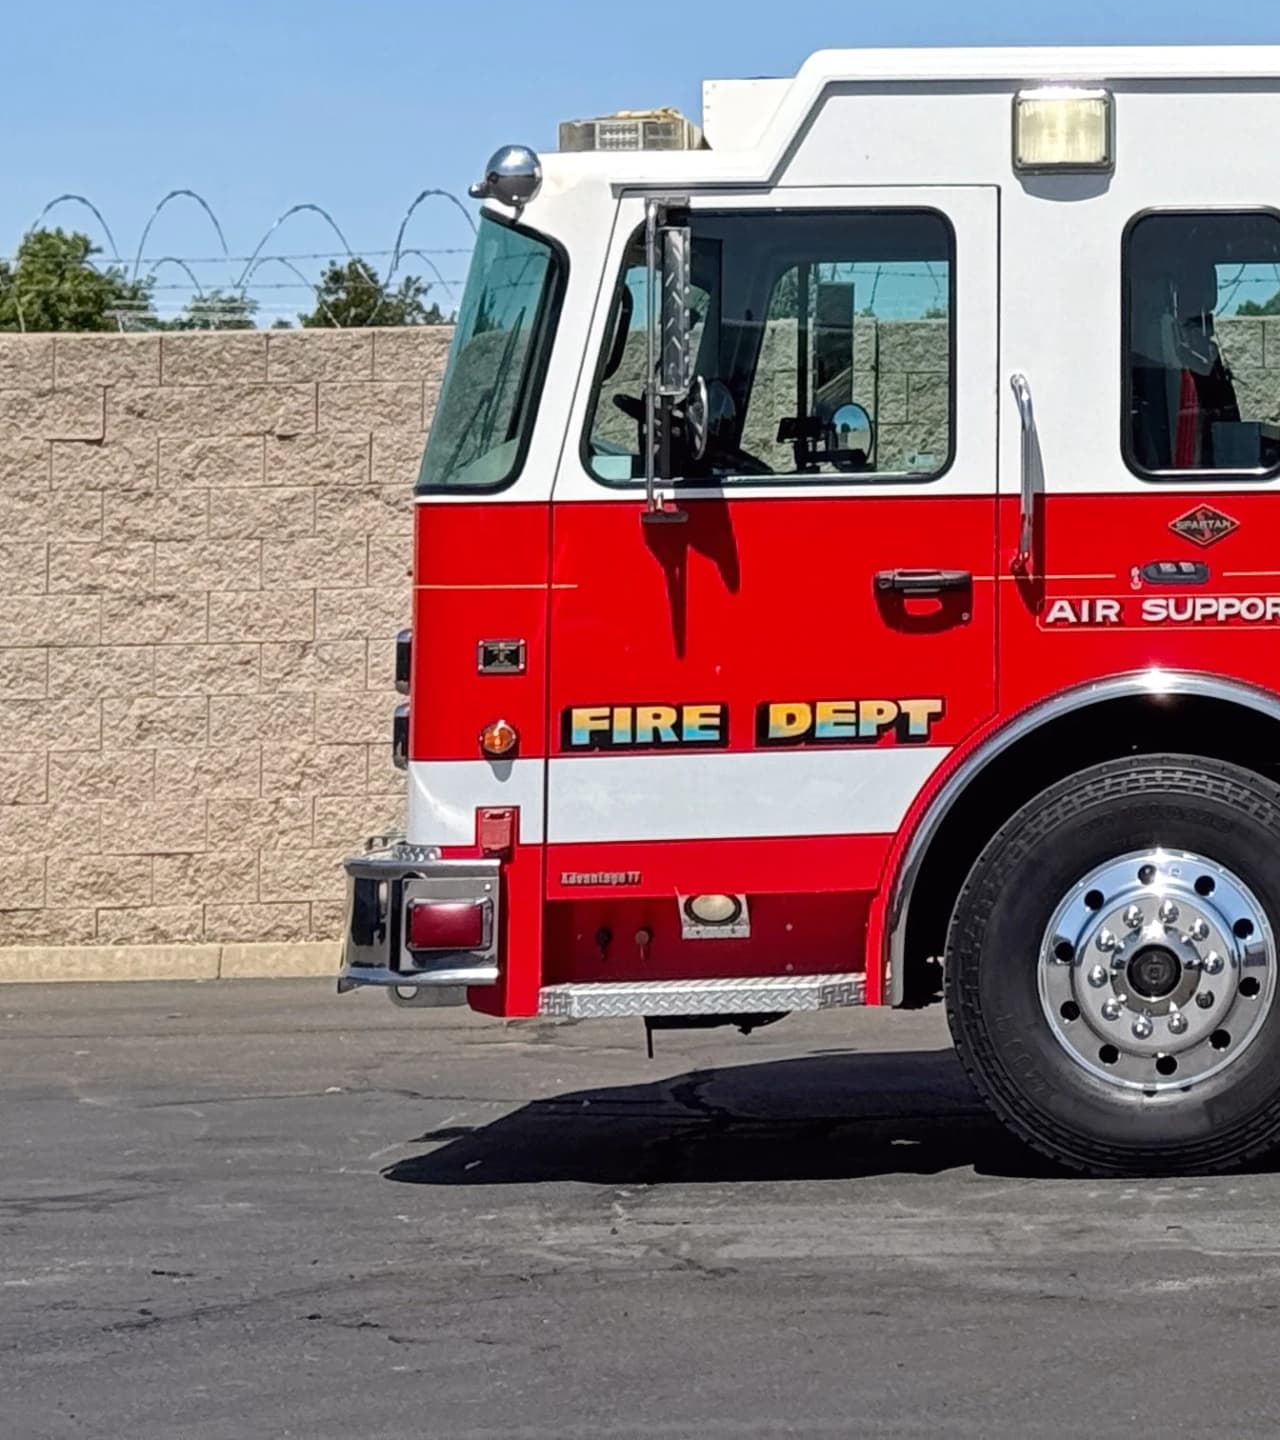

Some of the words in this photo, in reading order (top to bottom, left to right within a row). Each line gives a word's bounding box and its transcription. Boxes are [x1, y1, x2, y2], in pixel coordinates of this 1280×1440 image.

[1175, 519, 1231, 530] SPARTAN
[1045, 598, 1121, 623] AIR
[570, 703, 722, 746] FIRE
[767, 698, 943, 740] DEPT
[560, 871, 626, 886] Advantage
